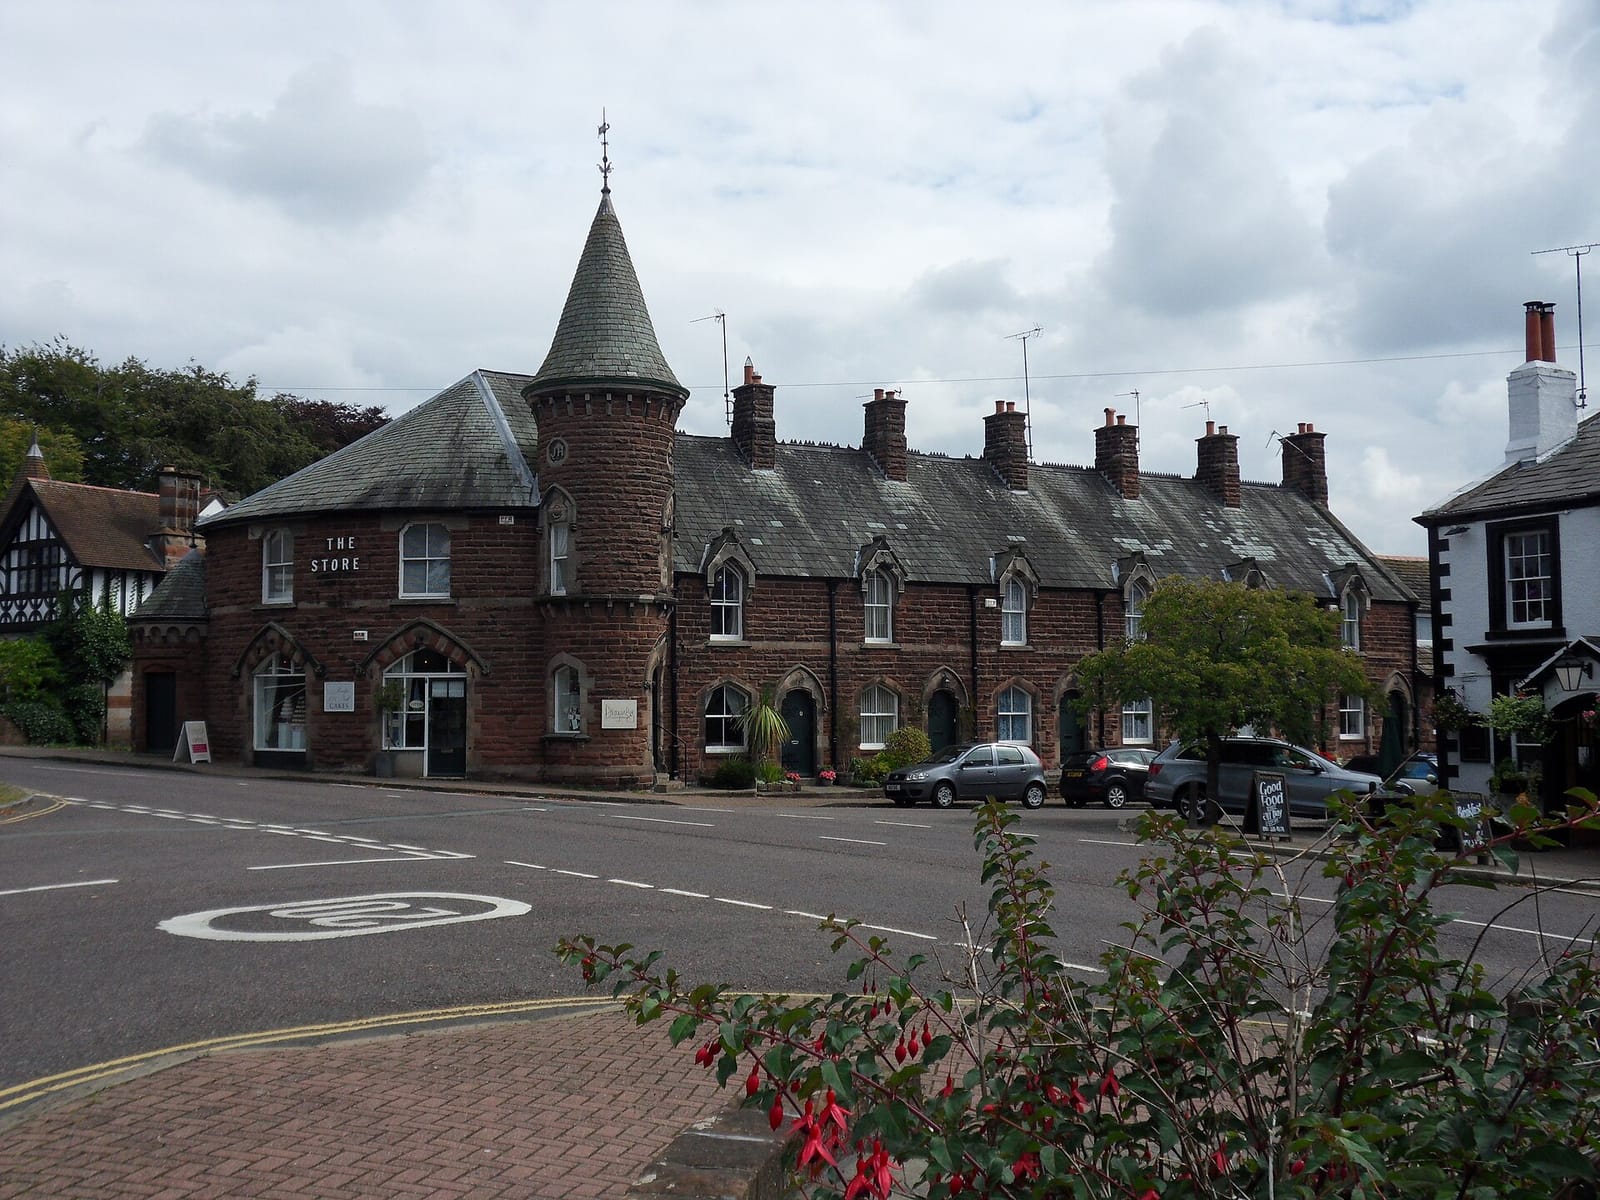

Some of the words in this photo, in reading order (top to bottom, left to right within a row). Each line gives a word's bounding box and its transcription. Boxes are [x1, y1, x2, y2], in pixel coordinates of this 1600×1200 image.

[326, 536, 355, 551] THE
[311, 557, 360, 572] STORE
[1259, 780, 1282, 795] Good
[1261, 792, 1284, 807] Food
[270, 901, 461, 927] 20
